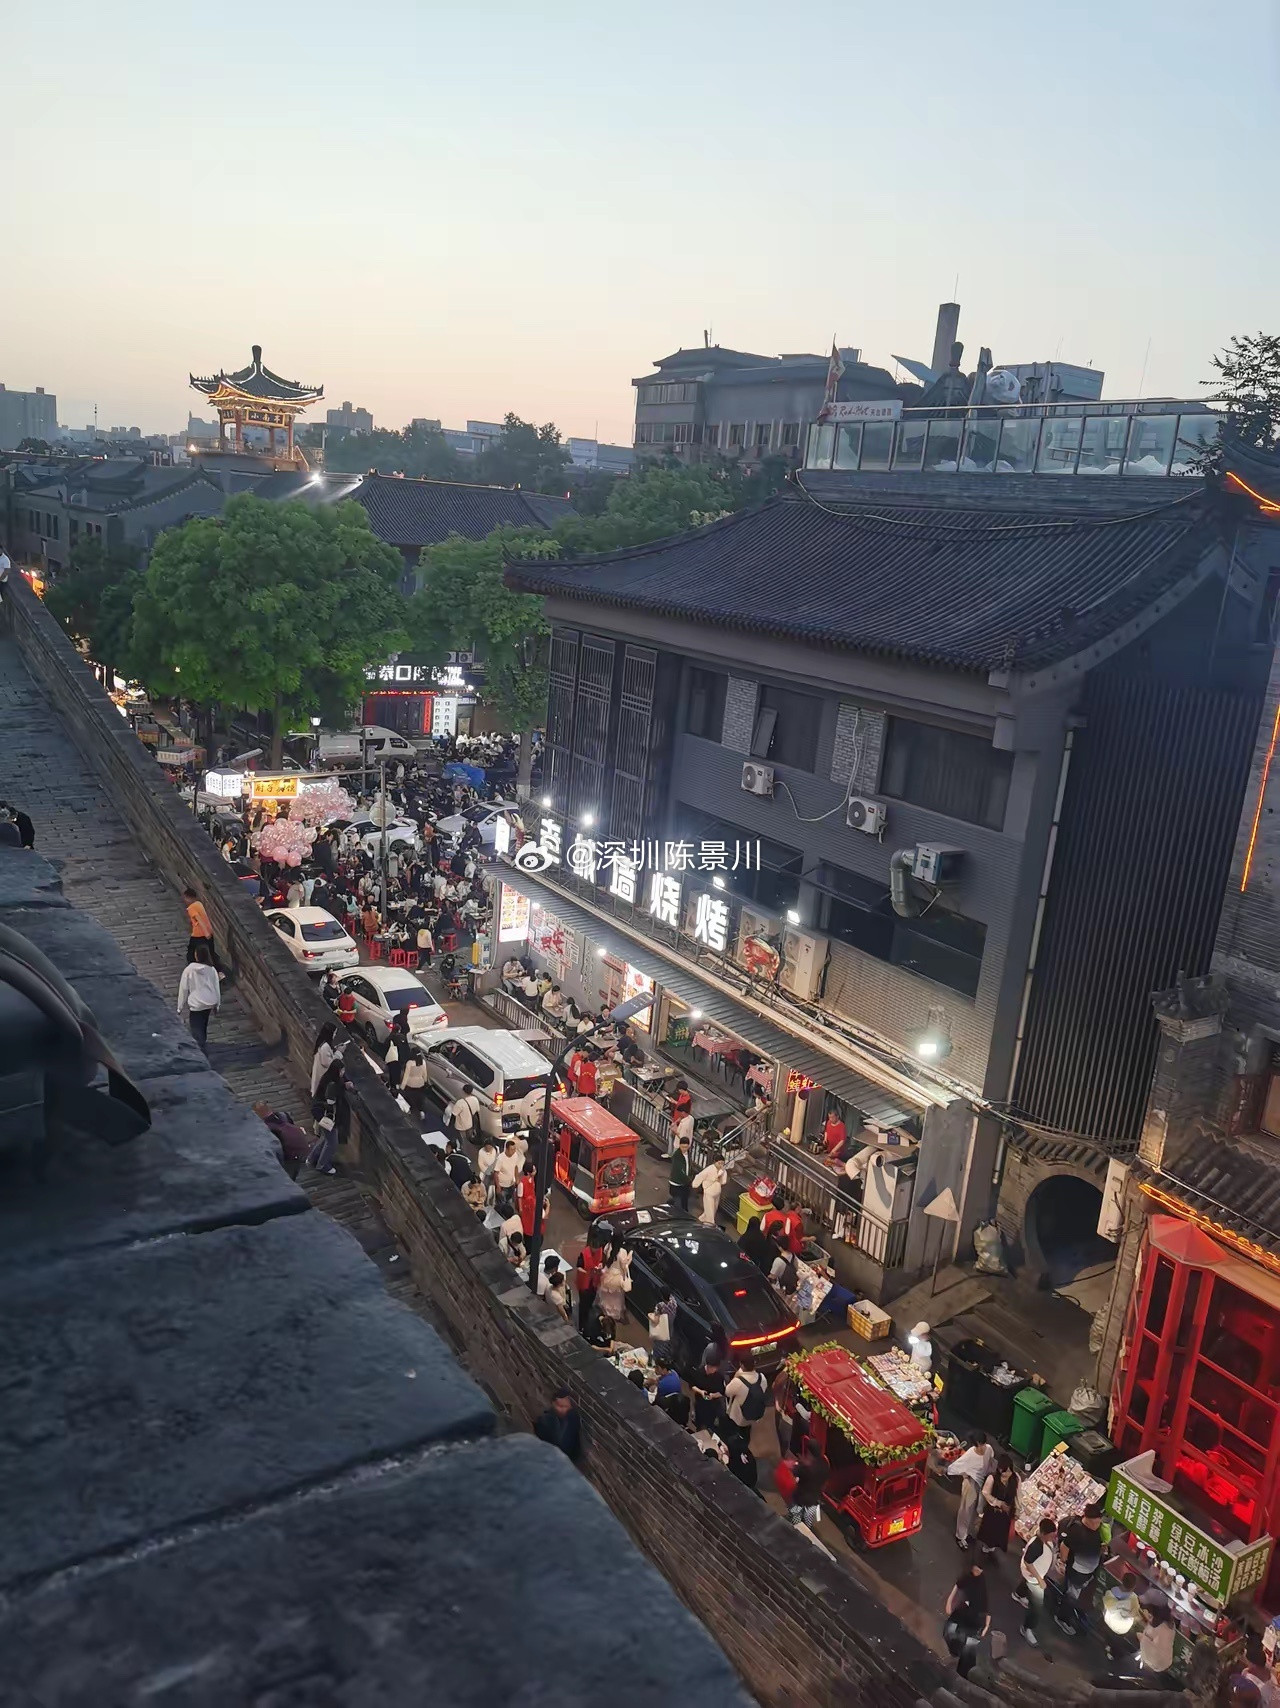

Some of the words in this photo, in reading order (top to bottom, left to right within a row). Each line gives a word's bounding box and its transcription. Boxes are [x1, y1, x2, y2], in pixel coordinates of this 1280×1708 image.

[1166, 1538, 1222, 1592] 桂花酸梅汤
[1170, 1522, 1224, 1572] 绿豆冰沙
